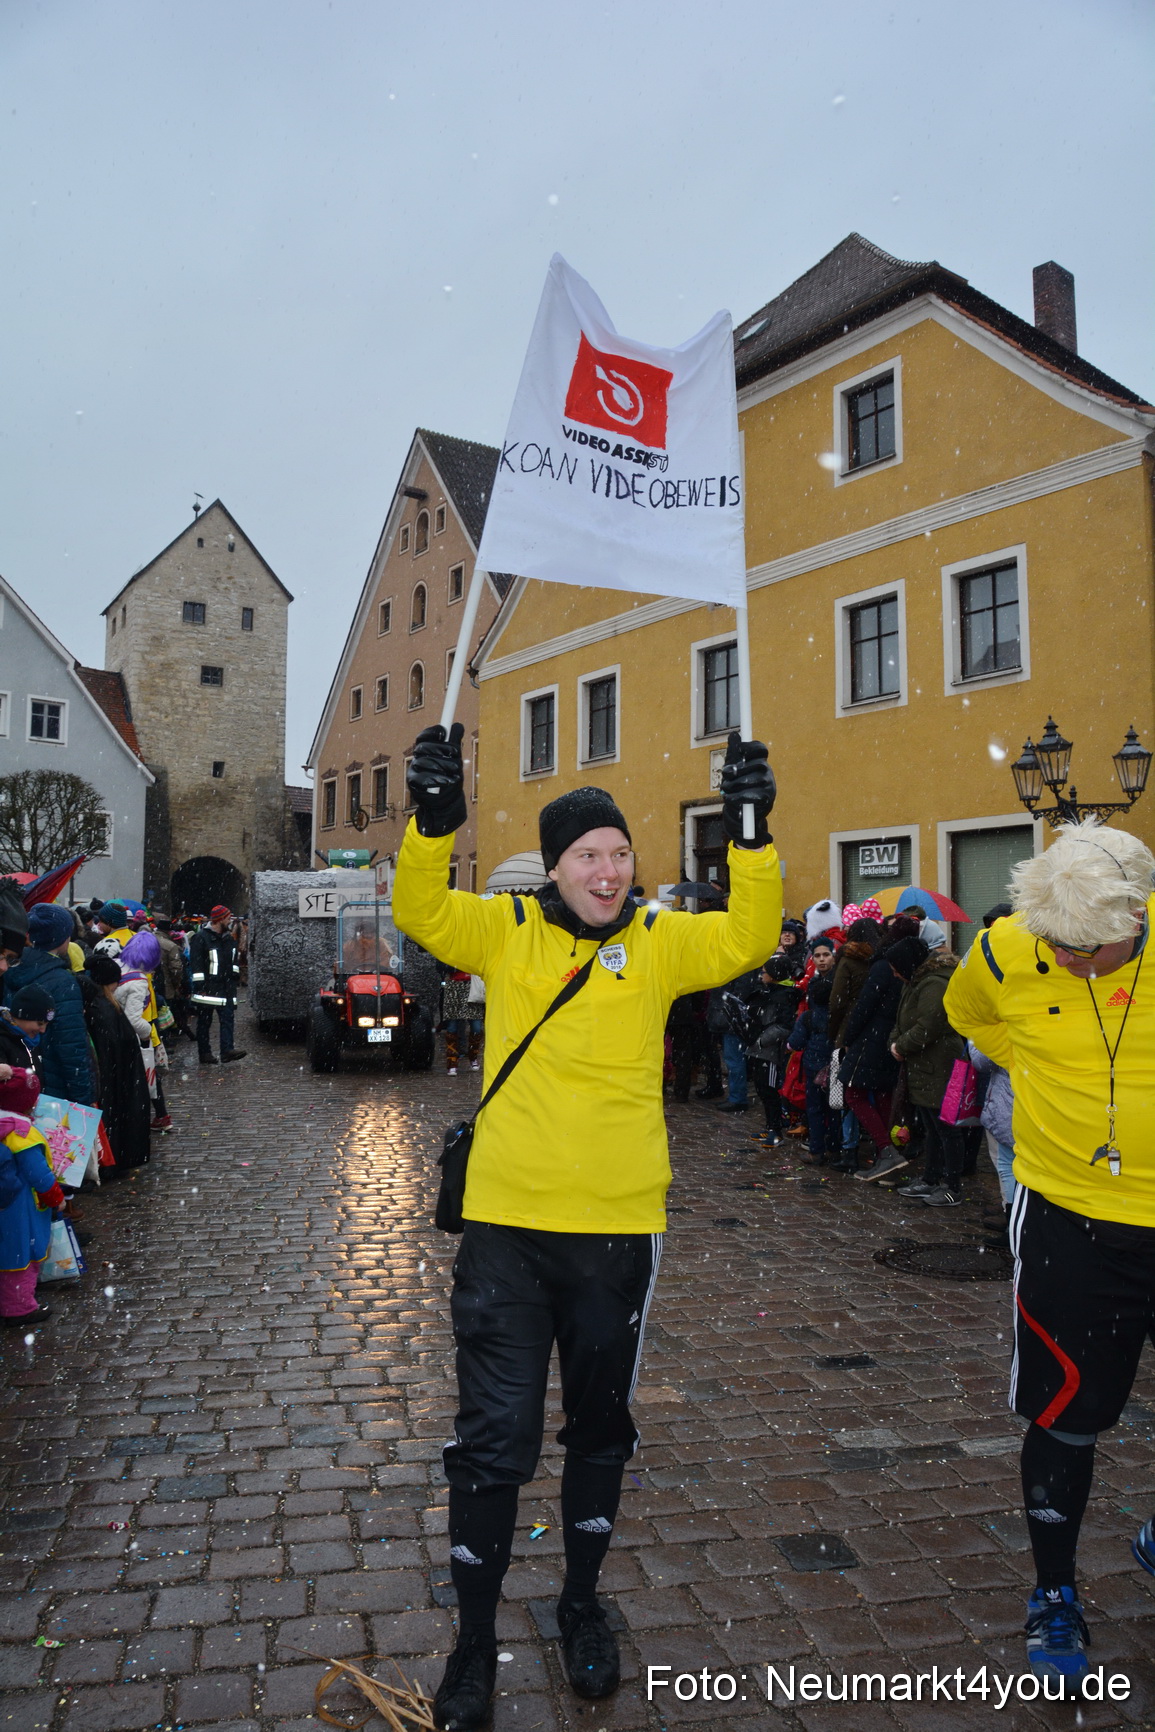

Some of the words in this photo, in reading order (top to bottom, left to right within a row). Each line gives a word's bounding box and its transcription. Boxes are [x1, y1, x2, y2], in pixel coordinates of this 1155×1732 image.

[562, 424, 611, 454] VIDEO
[500, 440, 578, 484] KOAN
[591, 458, 741, 509] VIDEOBEWEIS
[861, 845, 897, 864] BW
[860, 866, 899, 876] Bekleidung
[600, 945, 622, 953] SCHEISS
[1106, 998, 1137, 1007] adidas
[1029, 1510, 1067, 1523] adidas
[575, 1522, 612, 1533] adidas
